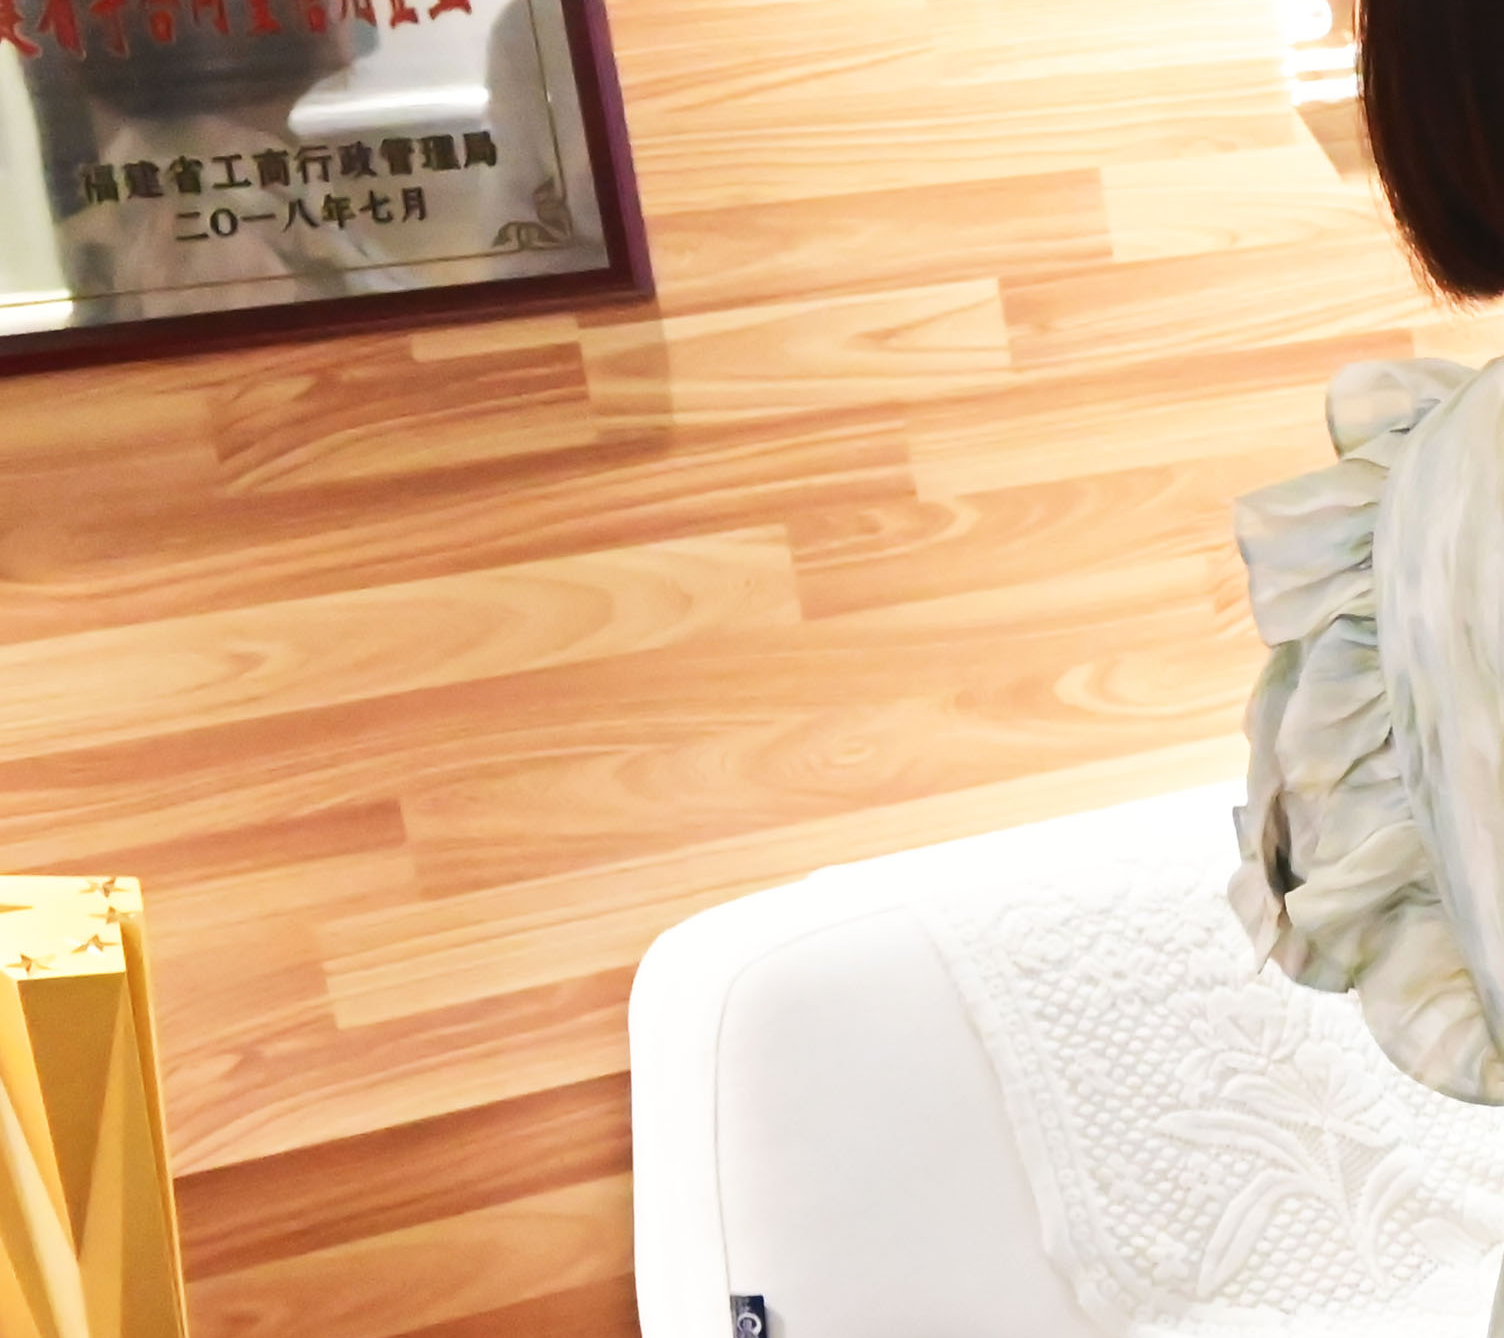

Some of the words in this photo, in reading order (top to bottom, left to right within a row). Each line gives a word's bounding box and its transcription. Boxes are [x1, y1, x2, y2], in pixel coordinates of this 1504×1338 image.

[82, 130, 498, 204] 福建省工商行政管理局
